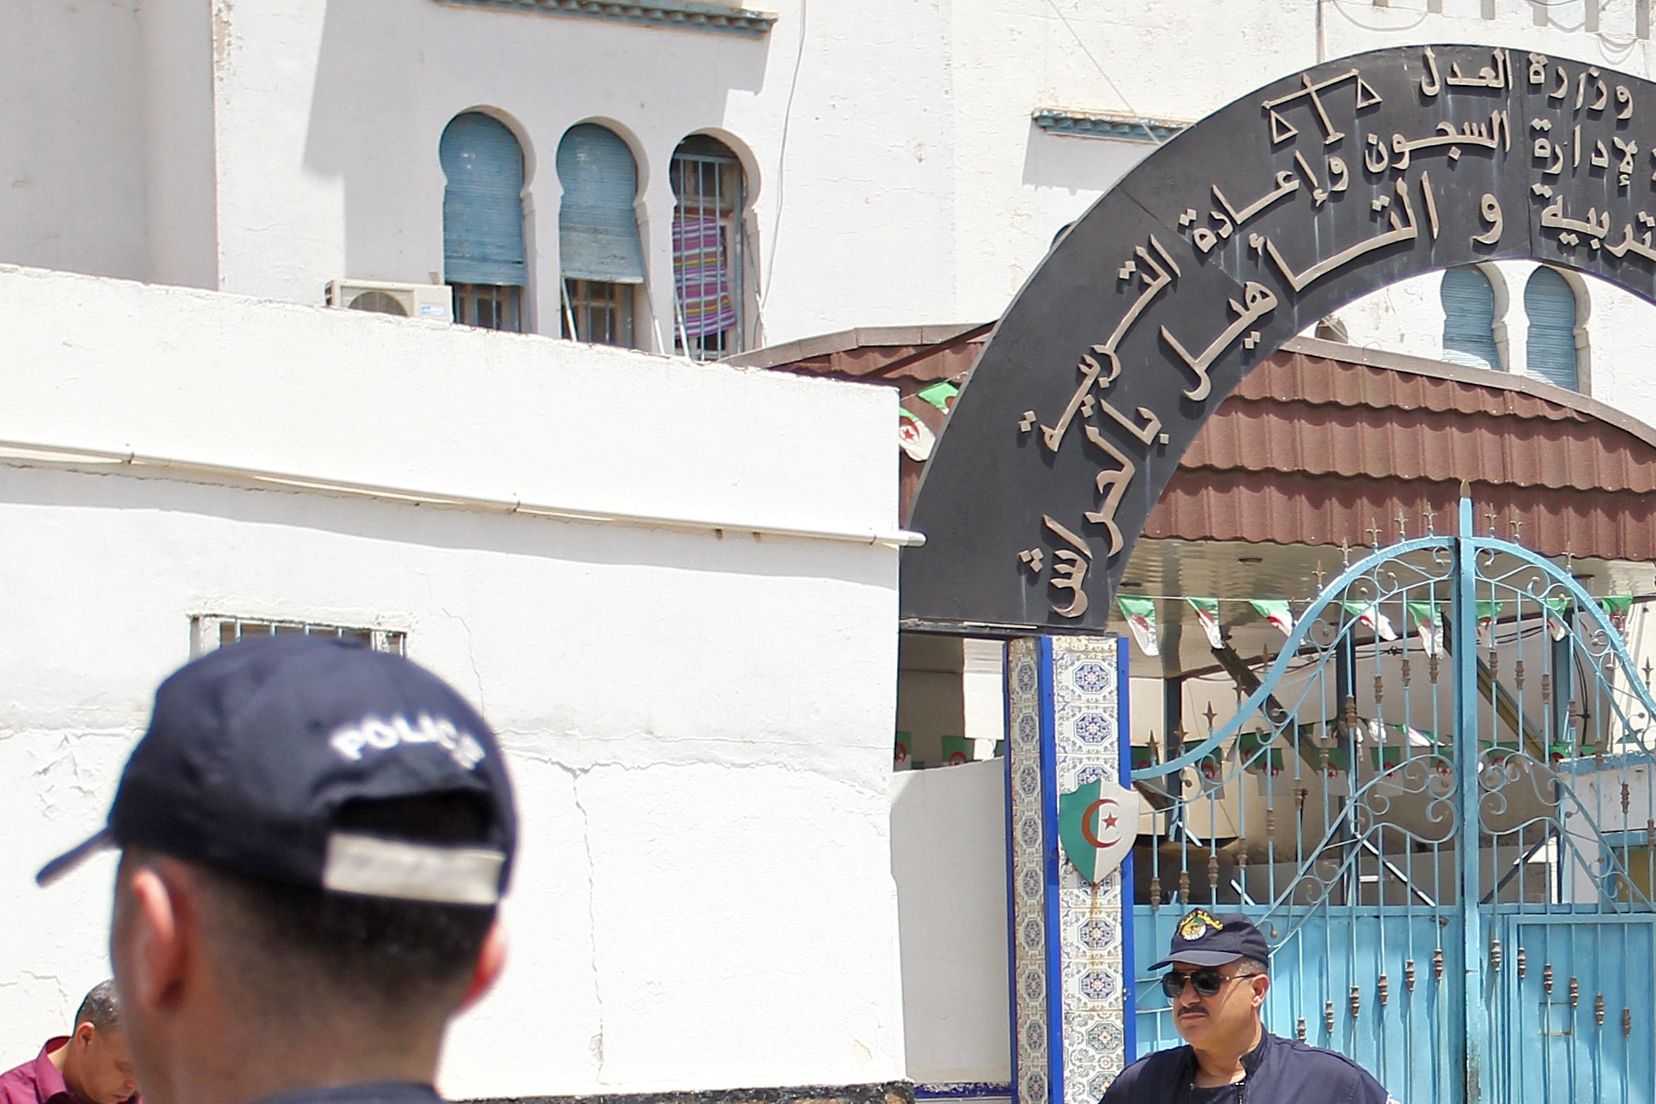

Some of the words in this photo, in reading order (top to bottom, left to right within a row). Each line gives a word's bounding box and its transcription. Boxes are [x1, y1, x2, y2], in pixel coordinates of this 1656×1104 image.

[1420, 46, 1513, 97] العدل
[1529, 53, 1634, 119] وزارة
[1366, 110, 1511, 173] السجون
[1533, 117, 1638, 187] لإدارة
[1161, 170, 1438, 403] التأهيل
[1018, 234, 1181, 452] التربية
[1018, 399, 1171, 617] بالحراش
